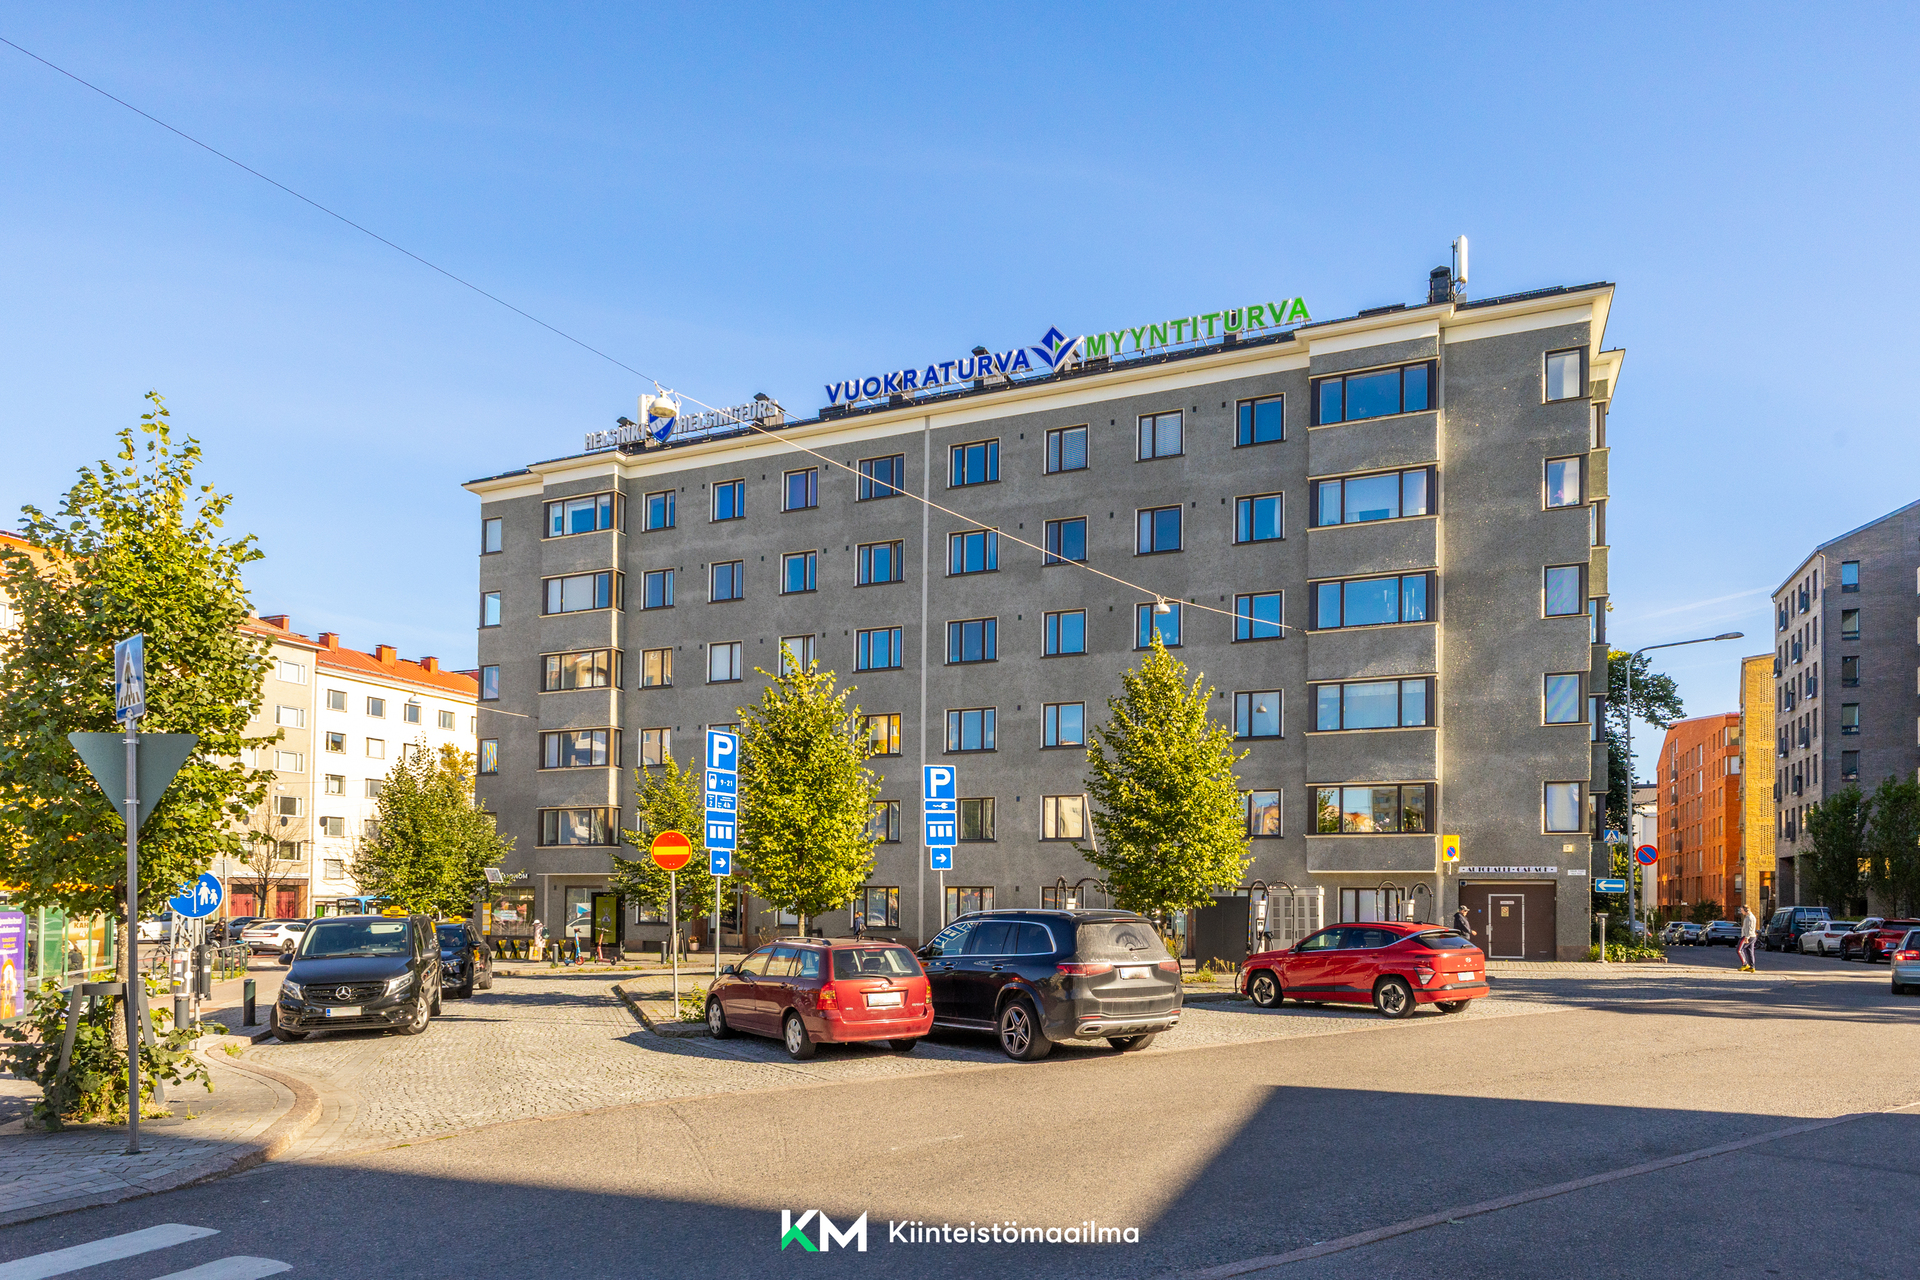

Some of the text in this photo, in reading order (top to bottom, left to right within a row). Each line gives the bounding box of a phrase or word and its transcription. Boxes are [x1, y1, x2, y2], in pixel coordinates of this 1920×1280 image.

[1086, 297, 1311, 359] MYYNTITURVA
[825, 348, 1032, 404] VUOKRATURVA
[585, 424, 646, 450] HELSINKI
[679, 399, 777, 432] HELSINGFORS
[713, 734, 733, 767] P
[720, 779, 733, 787] 9-21
[930, 768, 951, 797] P
